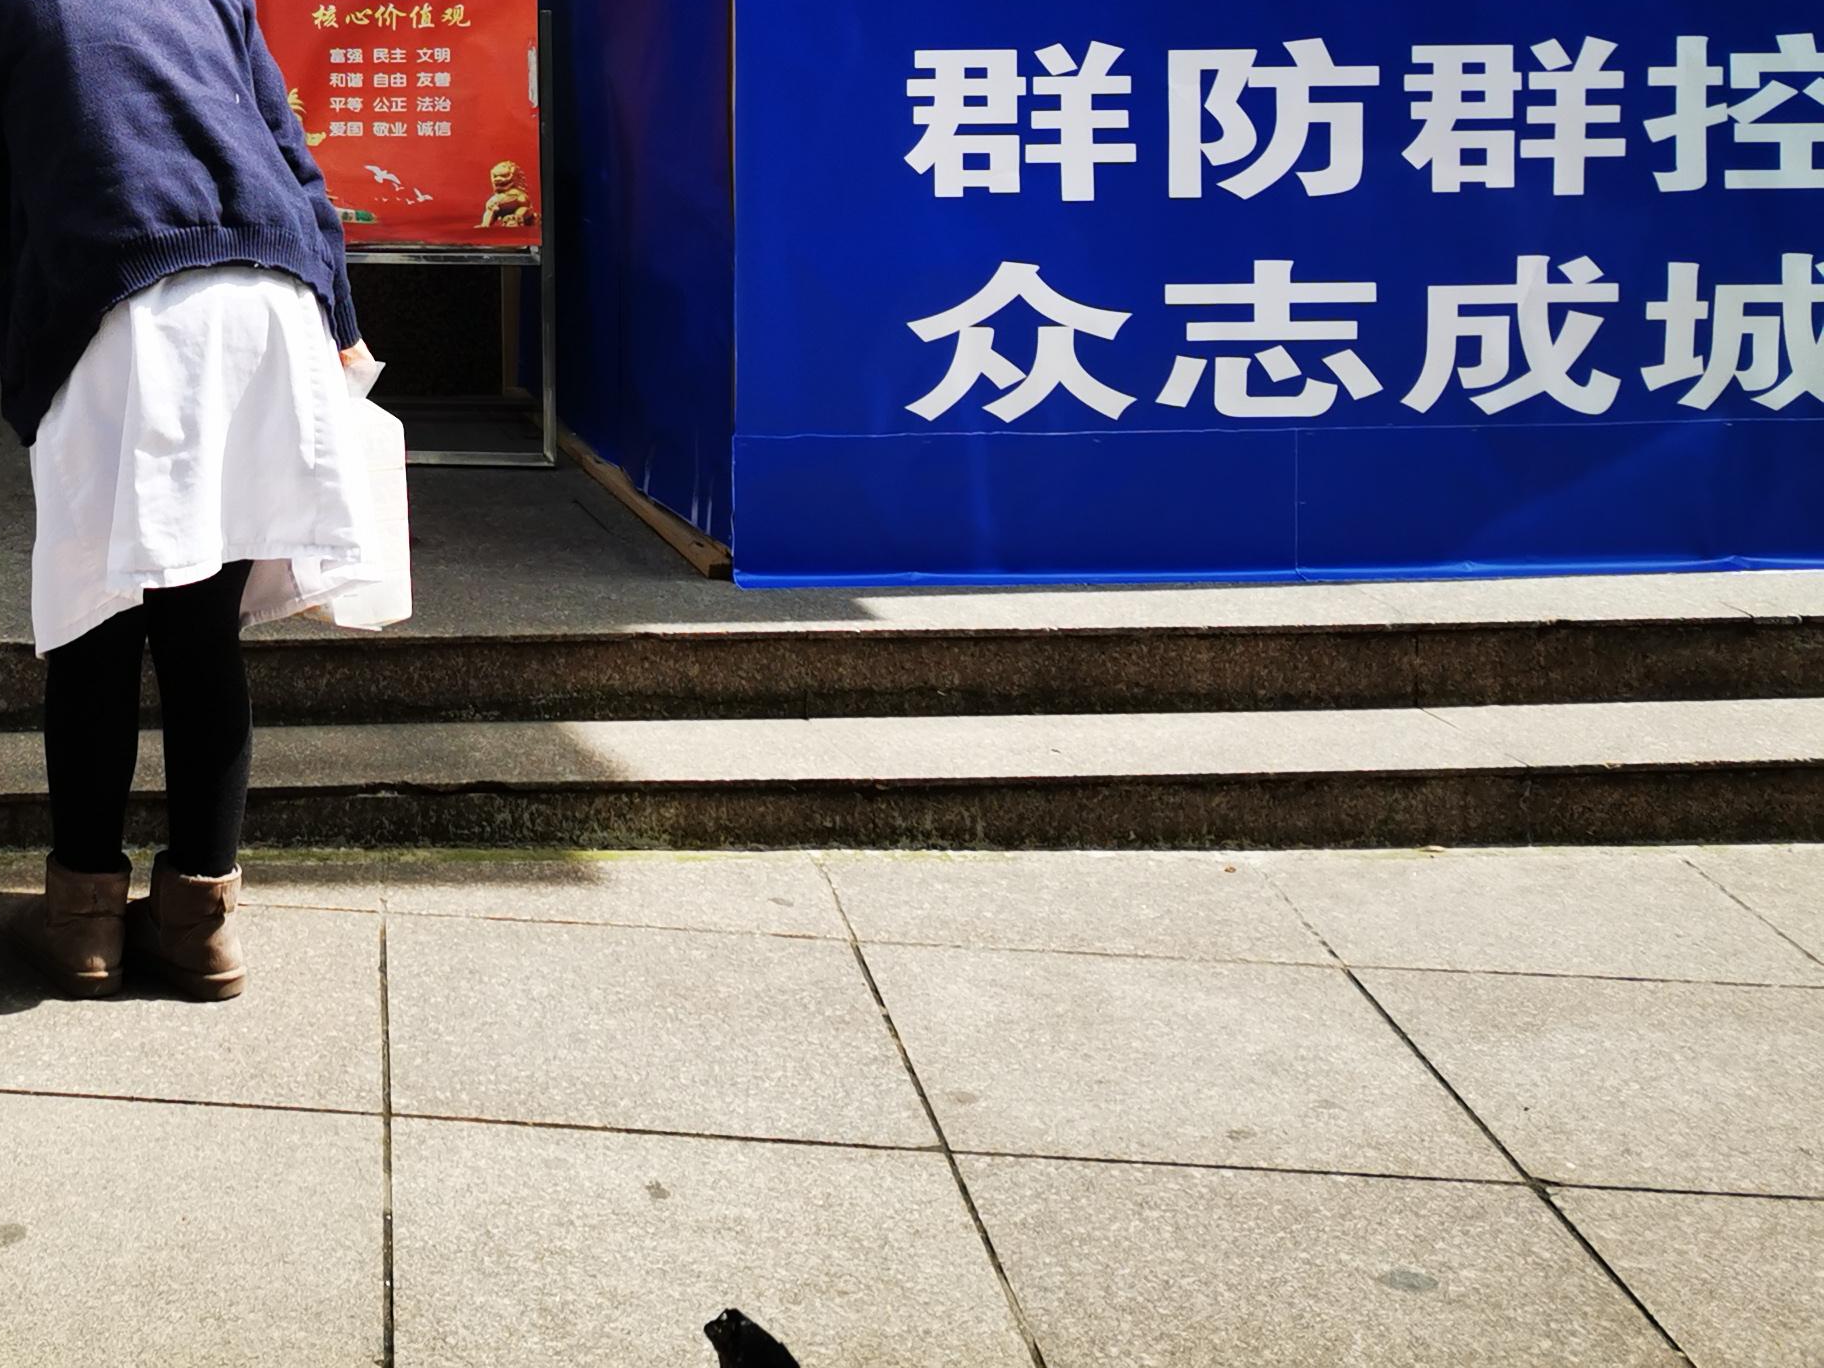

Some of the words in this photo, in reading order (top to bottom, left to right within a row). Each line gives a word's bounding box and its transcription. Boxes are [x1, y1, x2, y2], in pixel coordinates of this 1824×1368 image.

[311, 3, 472, 31] 核心价值观
[329, 48, 364, 64] 富强
[372, 48, 407, 64] 民主
[416, 48, 451, 64] 文明
[329, 72, 364, 88] 和谐
[372, 72, 407, 88] 自由
[416, 72, 451, 88] 友善
[329, 97, 364, 113] 平等
[372, 97, 407, 113] 公正
[416, 97, 451, 113] 法治
[904, 35, 1824, 202] 群防群控
[329, 121, 364, 137] 爱国
[372, 121, 407, 137] 敬业
[416, 121, 451, 137] 诚信
[905, 253, 1824, 423] 众志成城
